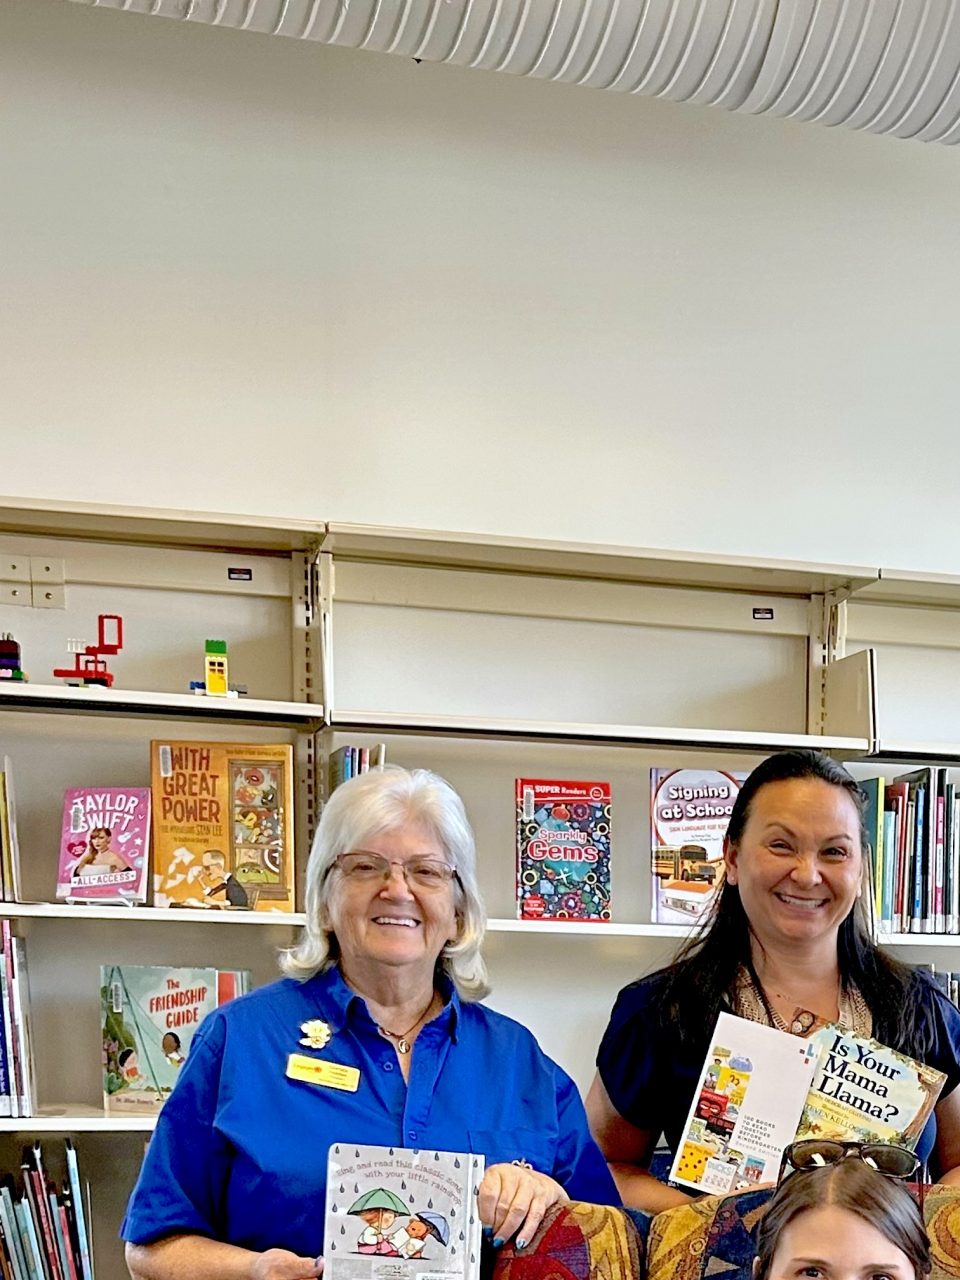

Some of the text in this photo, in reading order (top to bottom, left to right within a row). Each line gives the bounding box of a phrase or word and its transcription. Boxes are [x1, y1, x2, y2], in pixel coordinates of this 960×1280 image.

[172, 747, 210, 771] WITH
[163, 772, 219, 797] GREAT
[535, 785, 560, 794] SUPER
[561, 787, 586, 795] Readers
[668, 785, 729, 801] Signing
[73, 793, 139, 814] TAYLOR
[162, 797, 220, 823] POWER
[661, 803, 733, 819] at Schoo
[79, 812, 134, 833] SWIFT
[212, 825, 223, 837] LEE
[539, 829, 588, 844] Sparkly
[527, 840, 598, 862] Gems
[77, 873, 131, 886] ALL ACCESS
[166, 979, 180, 990] The
[149, 987, 207, 1014] FRIENDSHIP
[166, 1007, 199, 1029] GUIDE
[829, 1034, 901, 1081] Is Your
[822, 1053, 889, 1099] Mama
[817, 1074, 900, 1123] Llama?
[364, 1169, 384, 1179] with
[385, 1170, 405, 1180] your
[407, 1171, 429, 1184] little
[374, 1160, 393, 1168] read
[396, 1160, 412, 1169] this
[414, 1164, 445, 1180] classic
